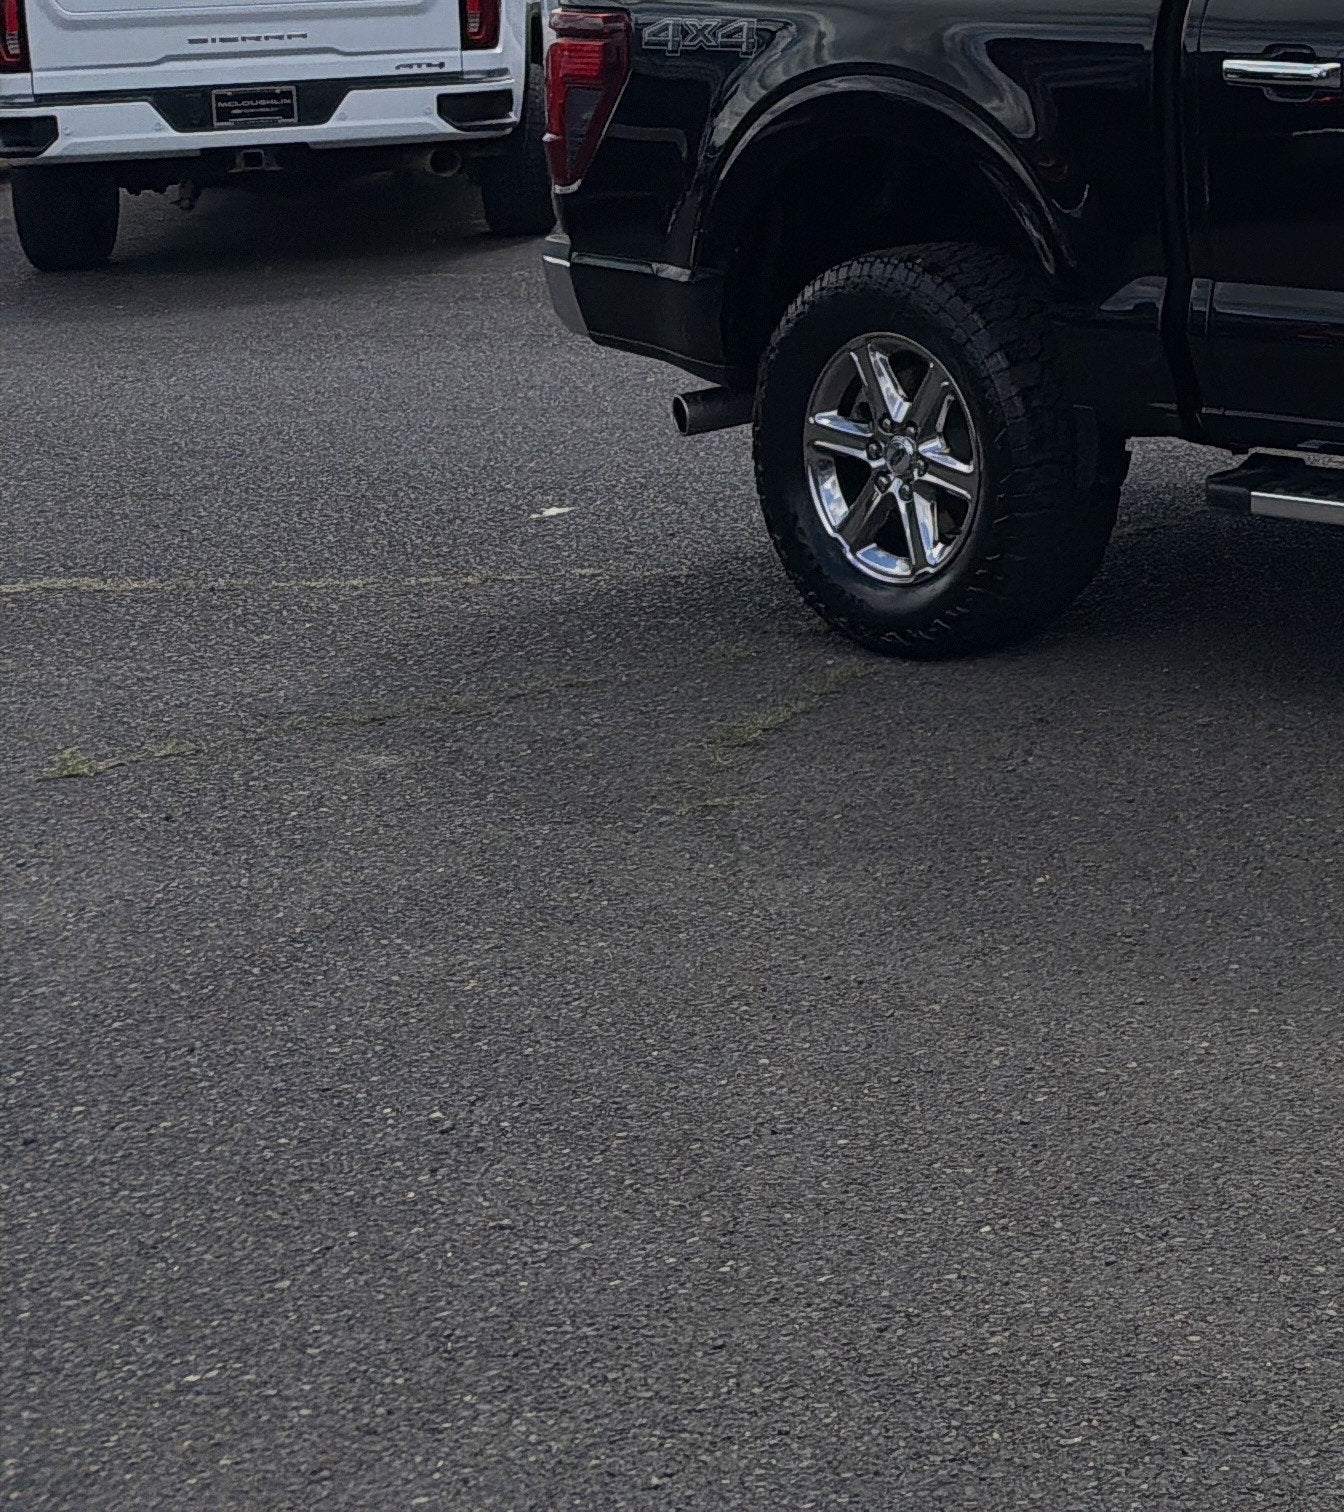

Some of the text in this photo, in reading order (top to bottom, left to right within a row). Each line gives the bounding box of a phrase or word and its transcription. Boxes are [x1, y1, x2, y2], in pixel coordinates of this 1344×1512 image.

[187, 33, 307, 44] SIERRA
[395, 61, 445, 70] AT4
[218, 99, 292, 107] MCLOUGHLIN
